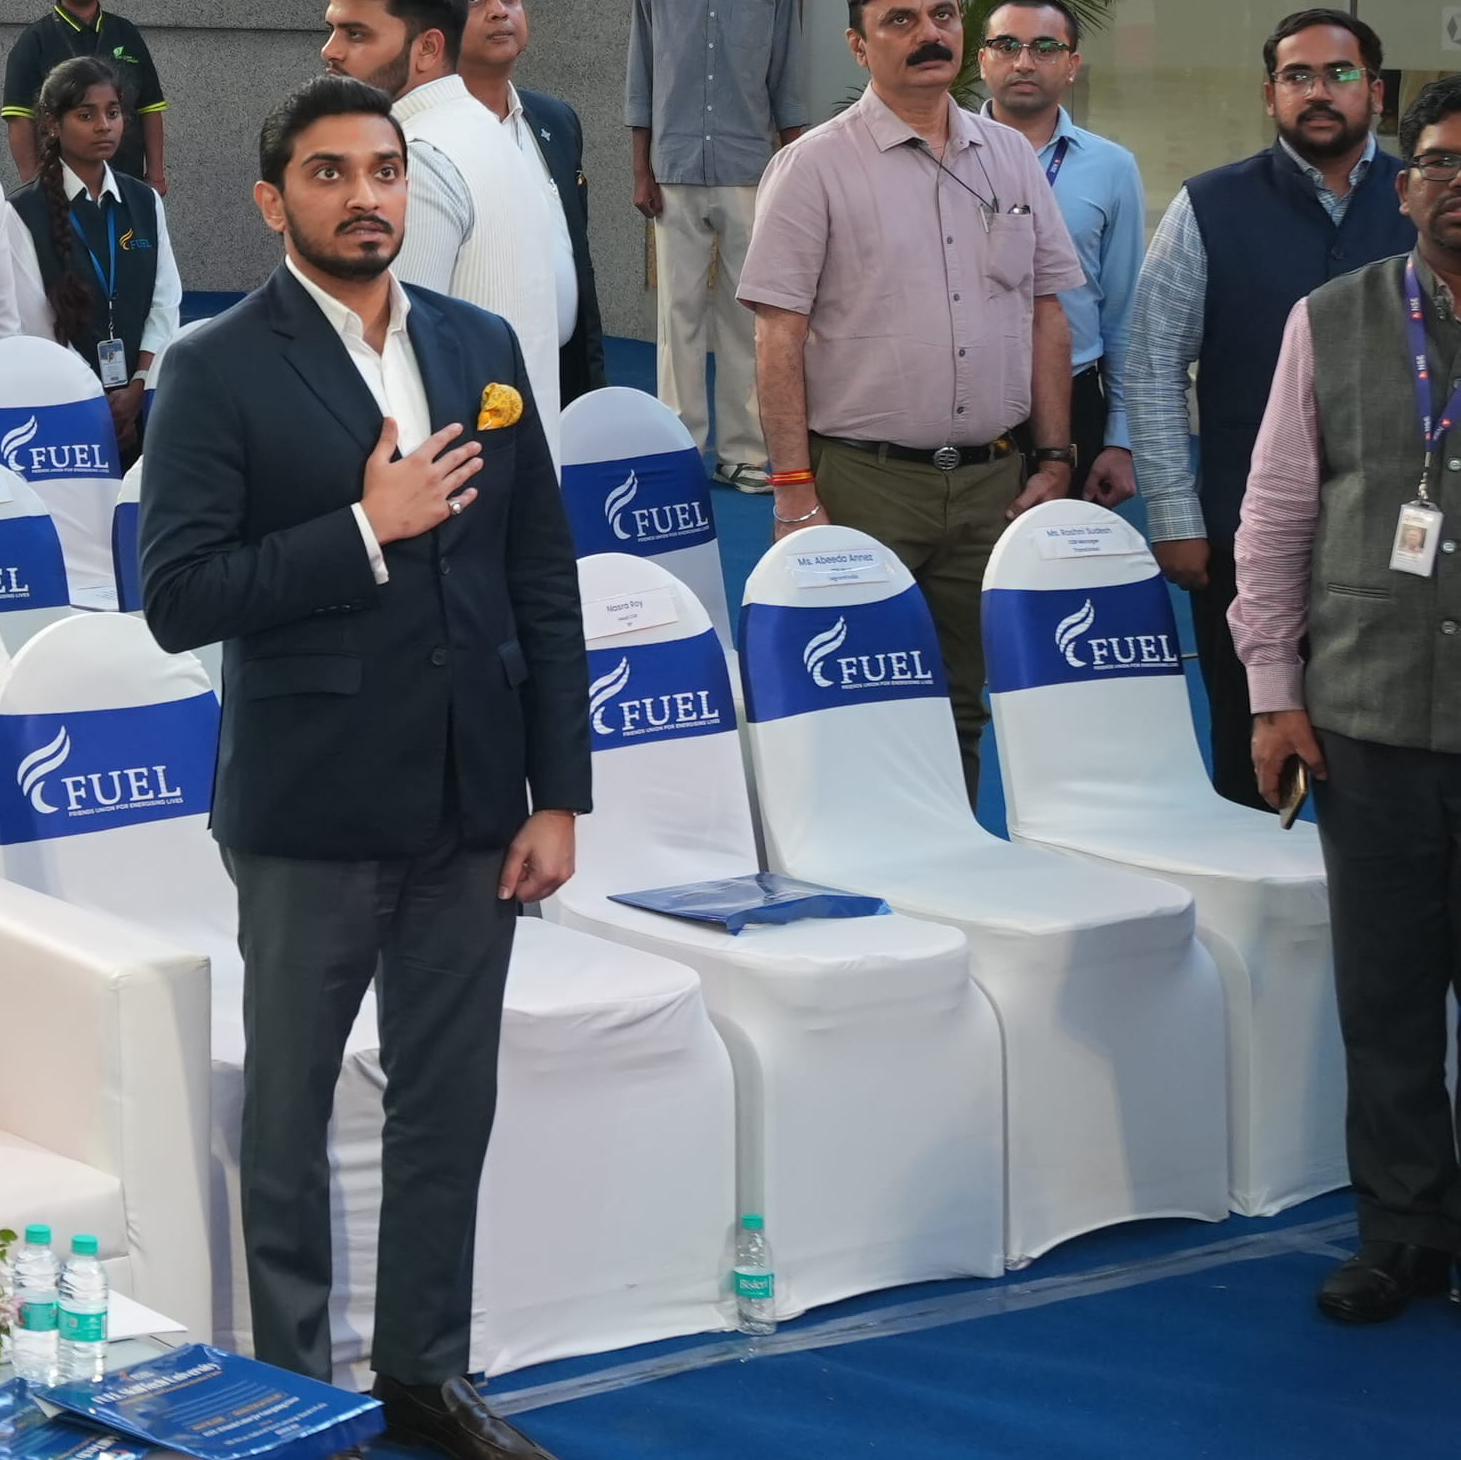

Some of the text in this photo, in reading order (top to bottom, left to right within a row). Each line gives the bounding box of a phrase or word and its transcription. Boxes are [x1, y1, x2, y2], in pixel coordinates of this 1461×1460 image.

[29, 444, 109, 469] FUEL
[632, 501, 709, 537] FUEL
[837, 650, 932, 684] FUEL
[1087, 635, 1178, 665] FUEL
[618, 691, 719, 731] FUEL
[61, 765, 182, 811] FUEL
